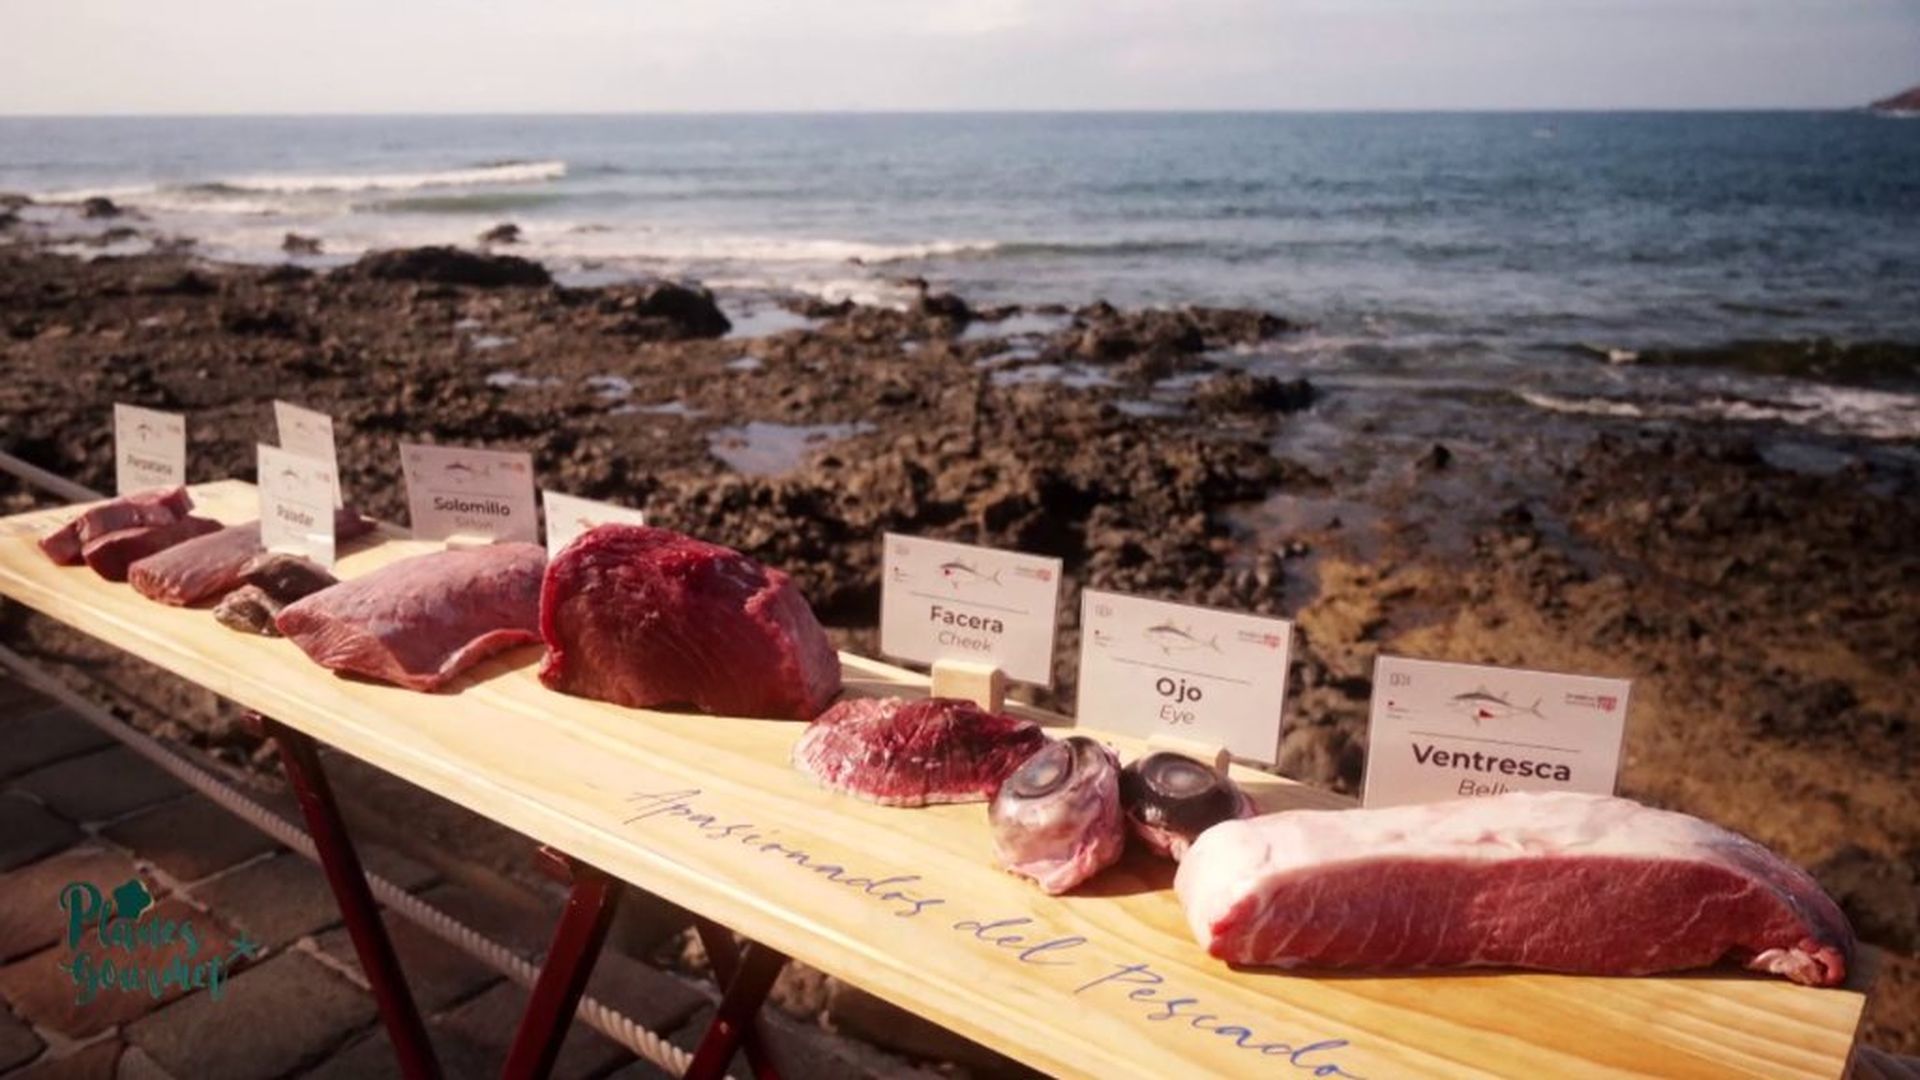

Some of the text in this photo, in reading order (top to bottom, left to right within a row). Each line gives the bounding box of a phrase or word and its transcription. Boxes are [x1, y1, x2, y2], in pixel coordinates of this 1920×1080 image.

[434, 497, 511, 517] Solomillo
[930, 605, 1004, 634] Facera
[938, 630, 992, 652] Cheek
[1156, 677, 1203, 703] Ojo
[1159, 704, 1195, 725] Eye
[1412, 743, 1571, 782] Ventresca
[623, 789, 1367, 1080] Apasionados del Pescado
